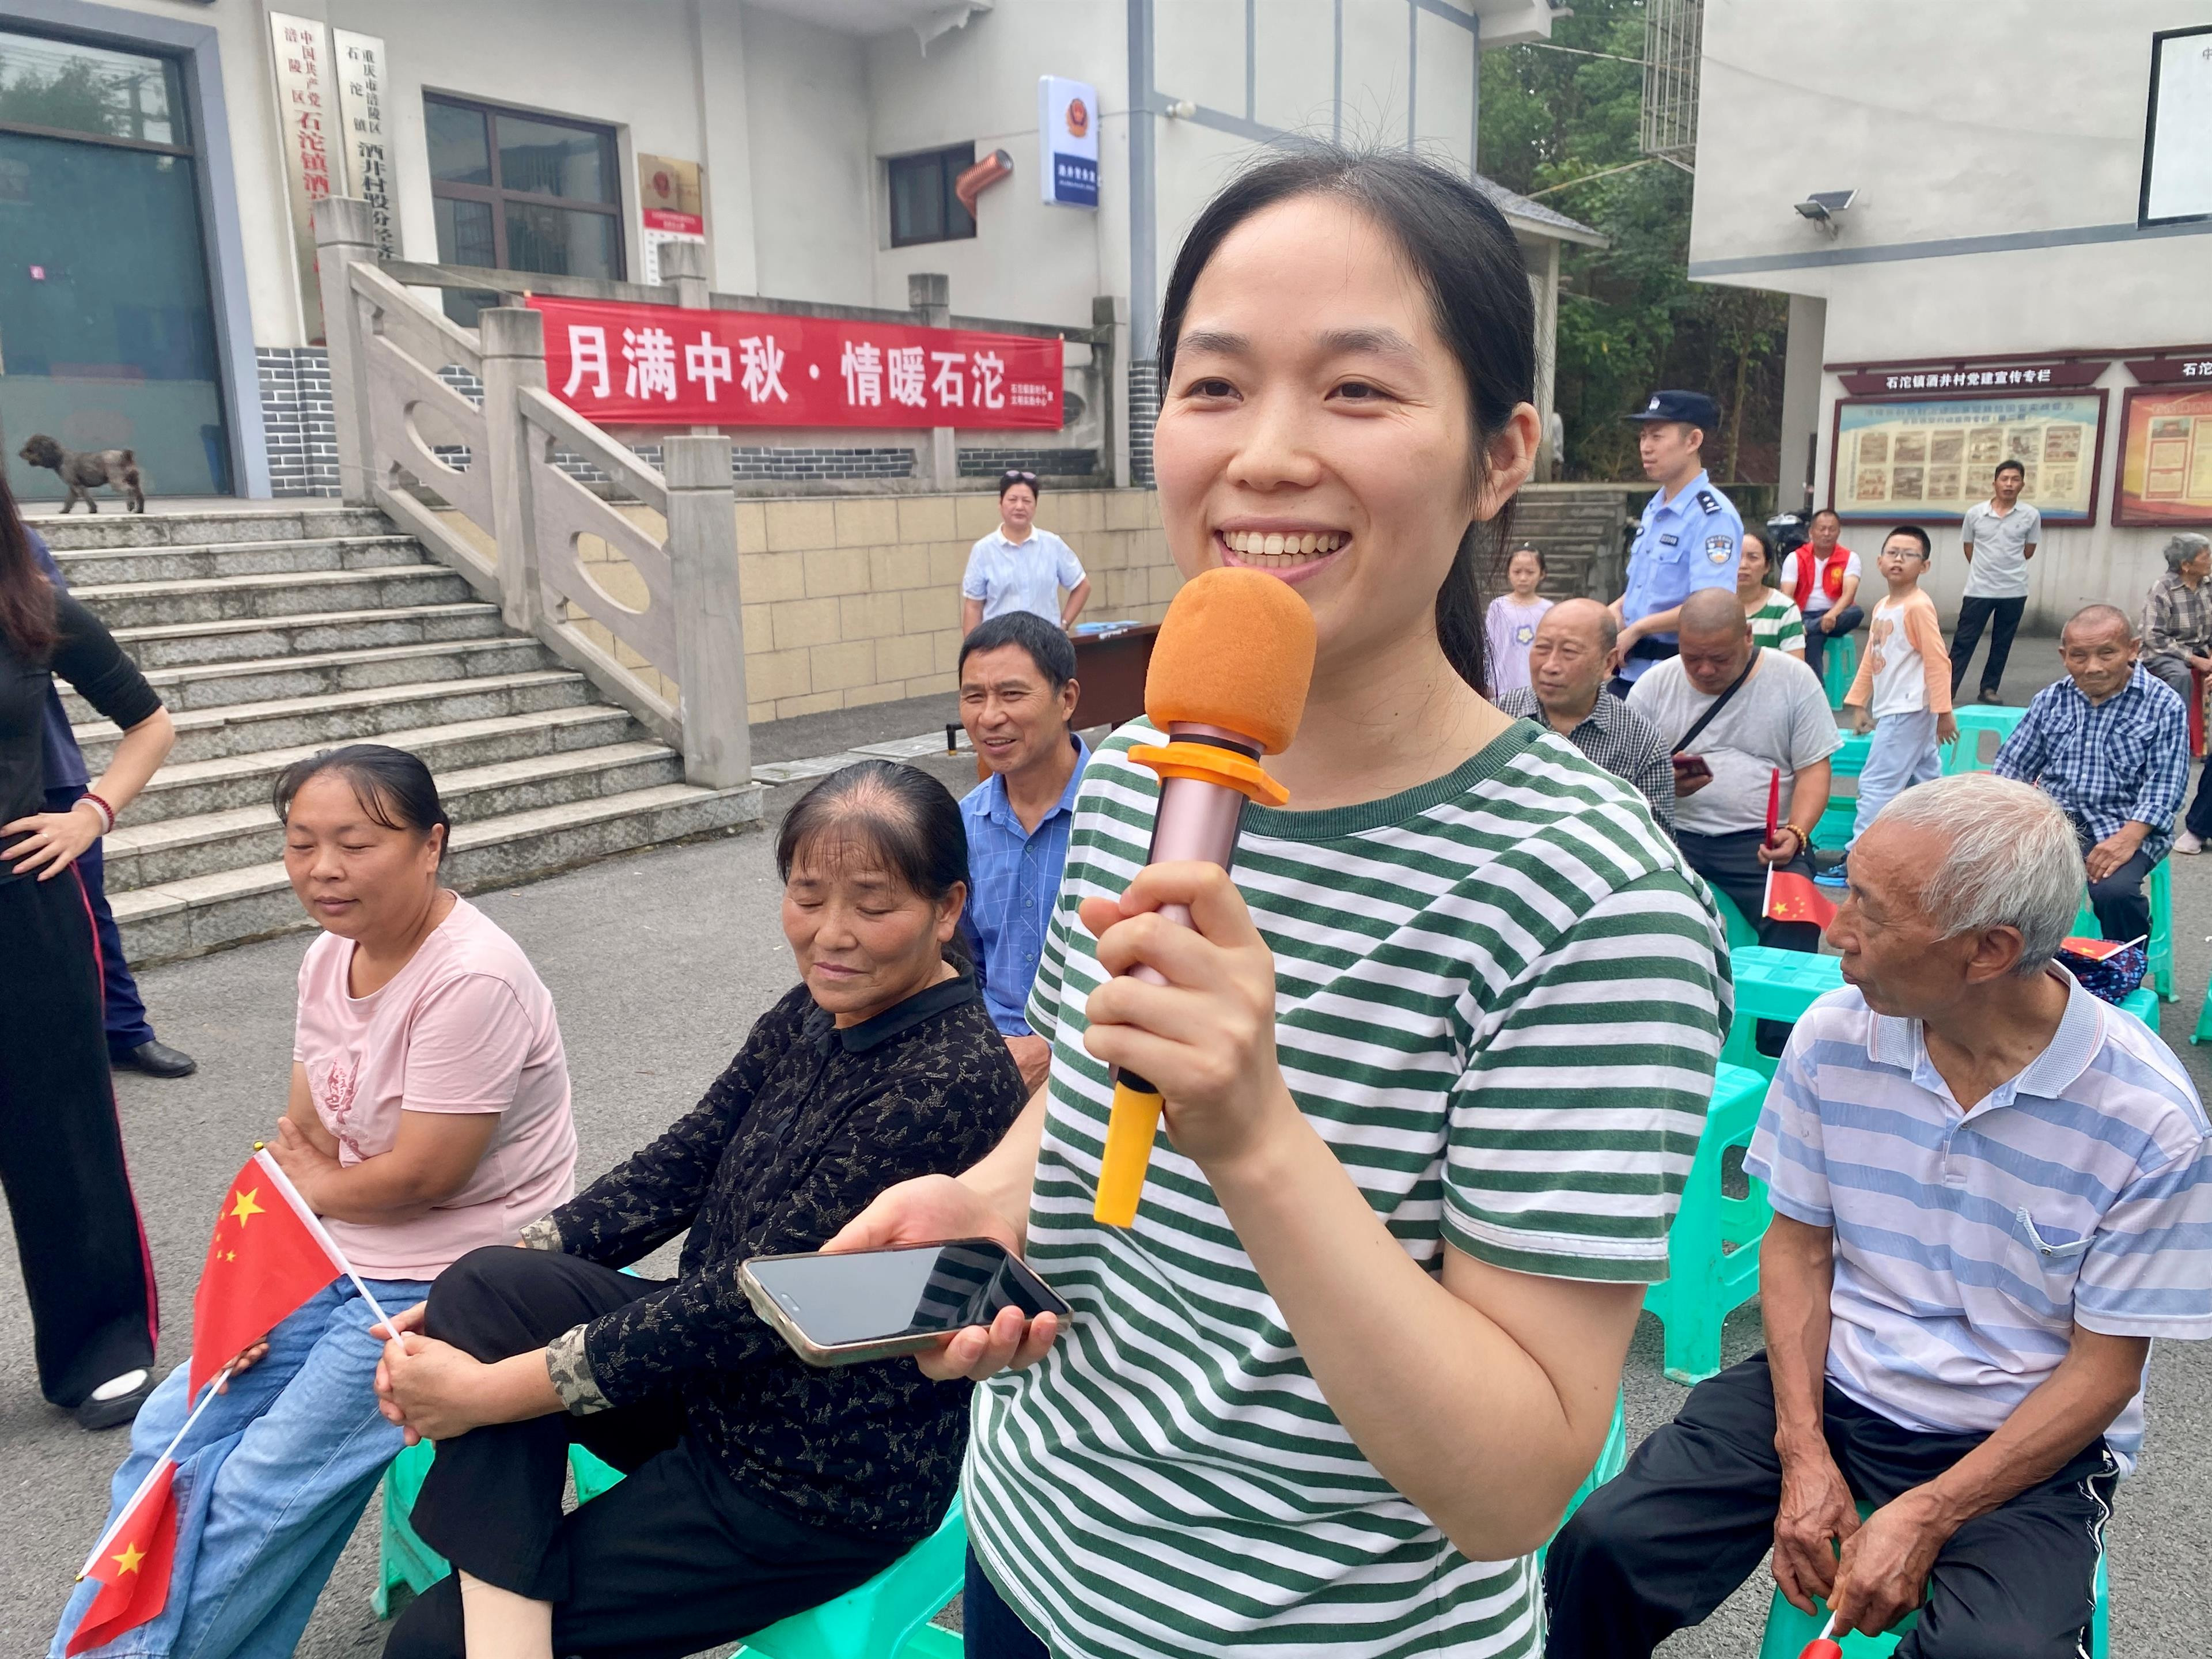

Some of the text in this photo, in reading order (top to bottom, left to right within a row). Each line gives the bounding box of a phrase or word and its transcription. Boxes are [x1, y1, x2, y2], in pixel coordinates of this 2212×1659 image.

[285, 27, 305, 104] 涪陵区
[301, 31, 321, 108] 中国共产党
[346, 46, 366, 133] 石沱镇
[363, 50, 381, 135] 重庆市涪陵区
[1886, 369, 2051, 389] 石沱镇酒井村党建宣传专栏
